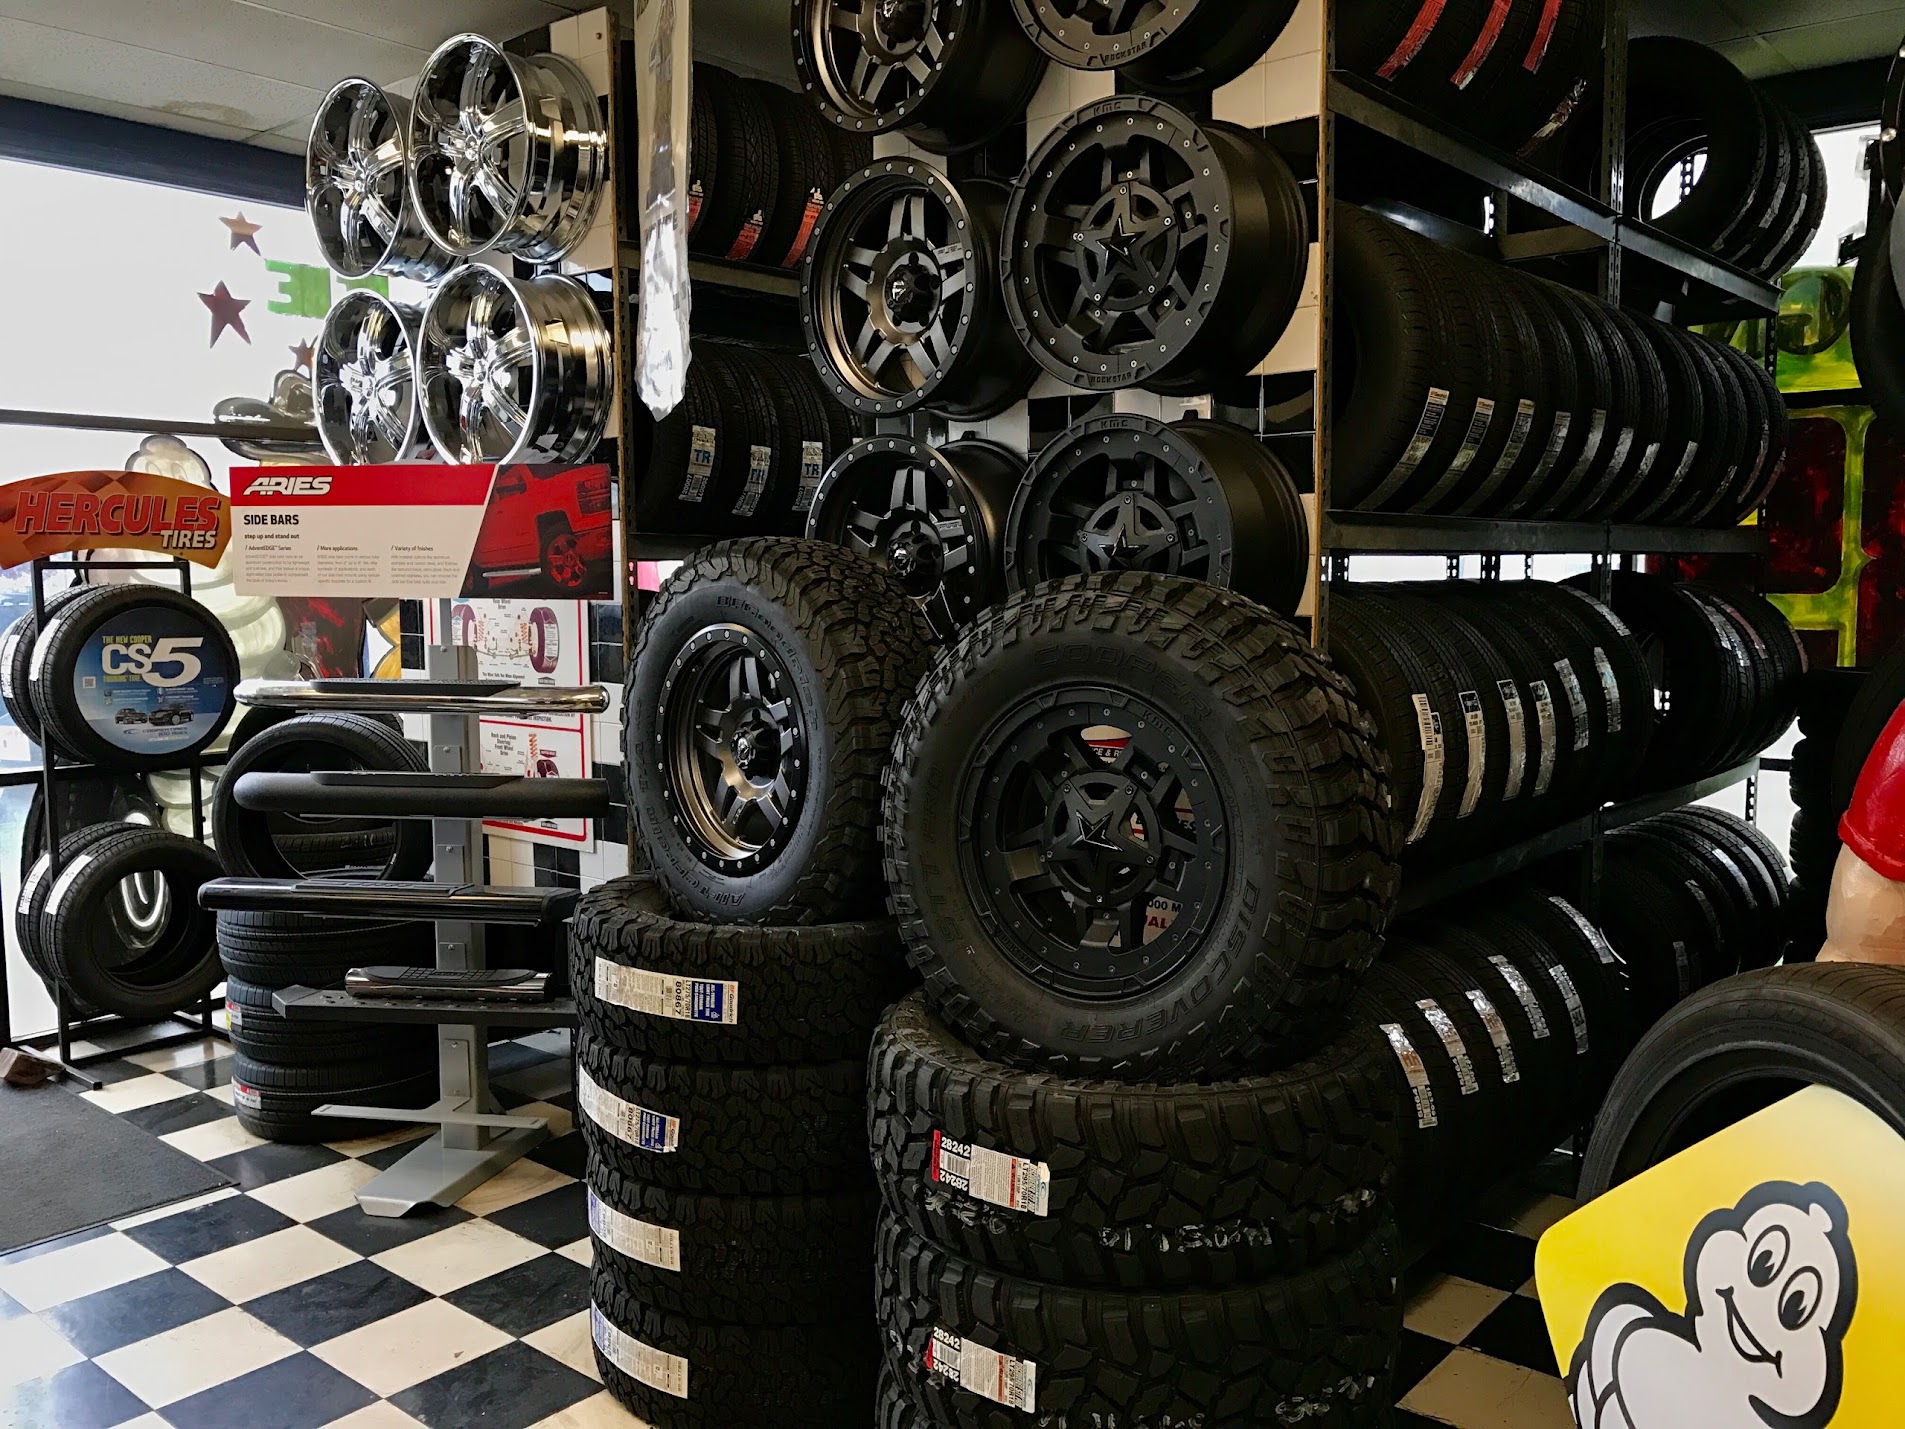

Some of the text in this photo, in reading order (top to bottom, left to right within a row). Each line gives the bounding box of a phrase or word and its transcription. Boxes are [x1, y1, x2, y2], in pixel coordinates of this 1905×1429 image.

[1104, 41, 1148, 62] ROCKSTAR
[1093, 102, 1122, 116] KMC
[1090, 372, 1132, 384] ROCKSTAR
[1100, 420, 1128, 429] KMC
[243, 476, 333, 496] ARIES
[14, 491, 220, 535] HERCULES
[243, 514, 300, 526] SIDE BARS
[160, 530, 217, 549] TIRES
[102, 635, 153, 644] THE NEW COOPER
[101, 637, 204, 688] CS5
[1034, 643, 1212, 718] COOPER
[1105, 748, 1111, 757] &
[1059, 878, 1260, 1043] DISCOVERER
[940, 1136, 971, 1157] 28242
[939, 1170, 969, 1192] 28242
[933, 1326, 960, 1350] 28242
[932, 1359, 960, 1382] 28242
